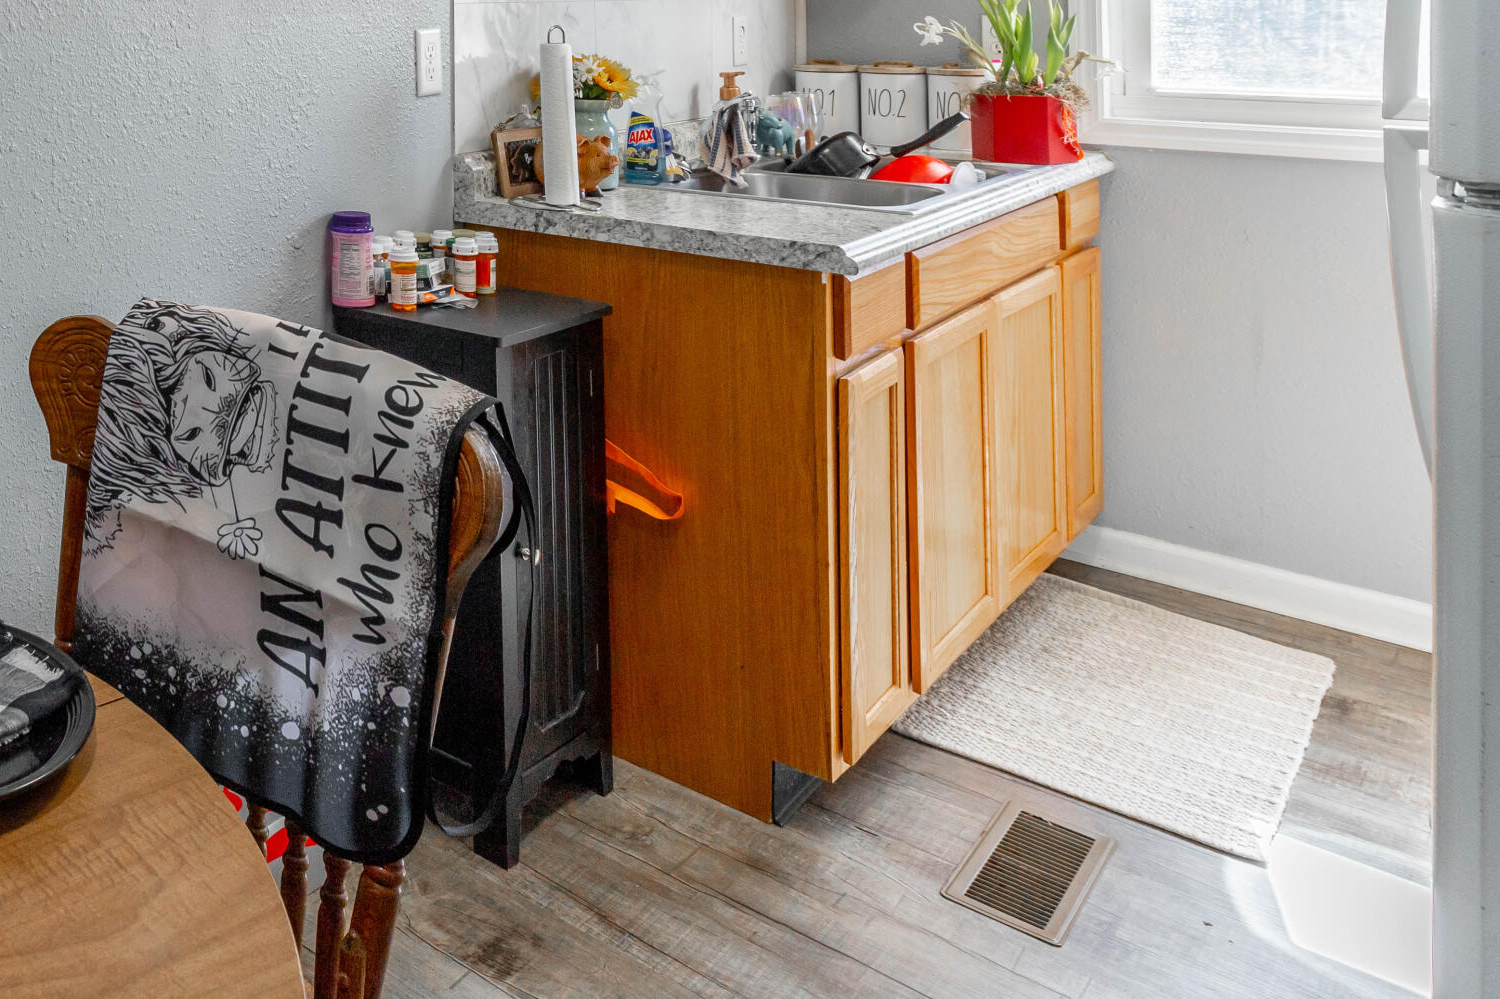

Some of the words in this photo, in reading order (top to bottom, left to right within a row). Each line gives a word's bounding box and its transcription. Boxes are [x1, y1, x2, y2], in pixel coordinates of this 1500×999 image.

[628, 128, 655, 145] AJAX
[866, 87, 908, 119] NO.2
[336, 521, 403, 647] who
[256, 562, 329, 700] AN
